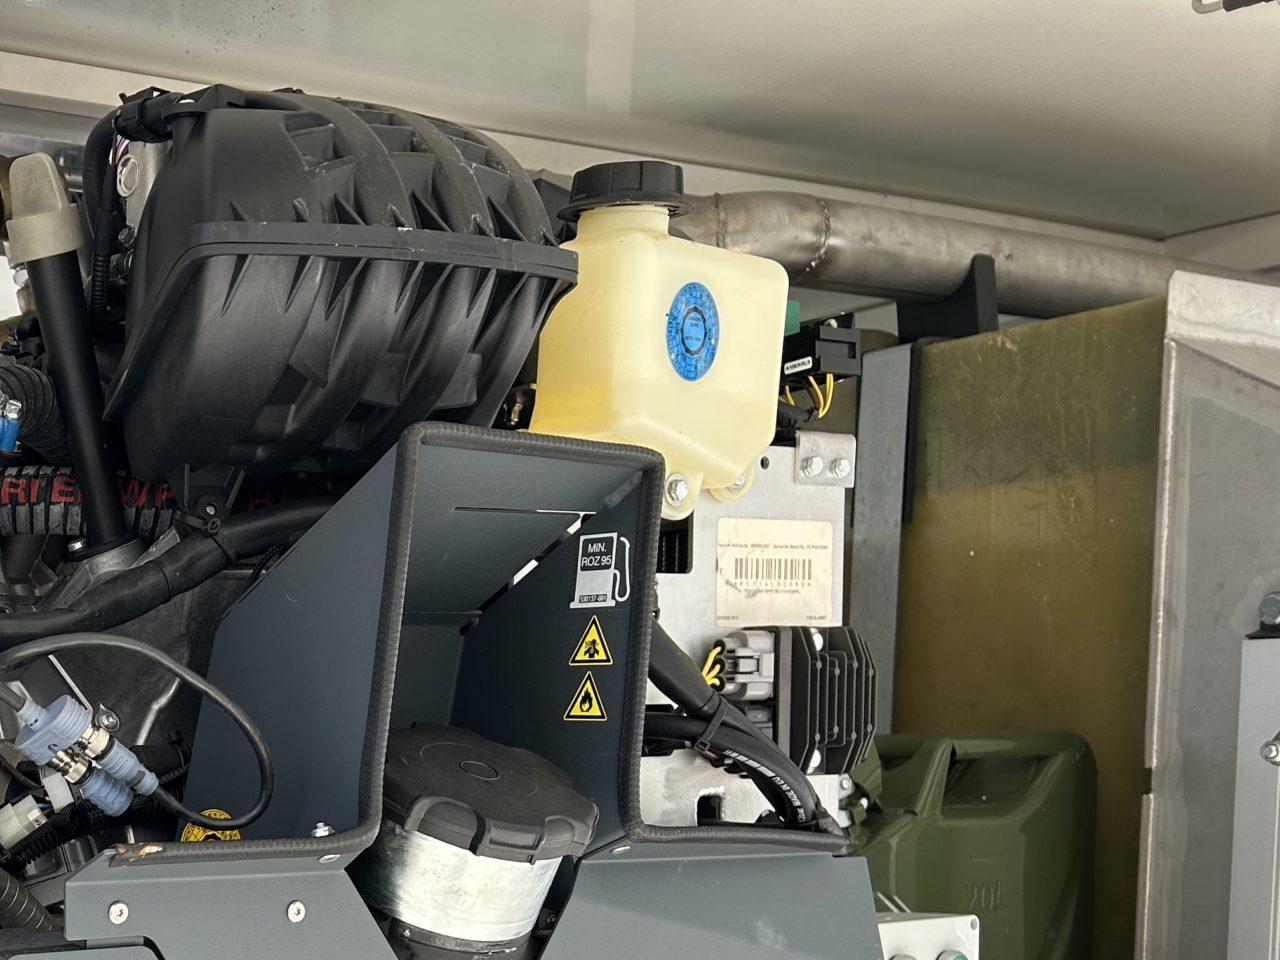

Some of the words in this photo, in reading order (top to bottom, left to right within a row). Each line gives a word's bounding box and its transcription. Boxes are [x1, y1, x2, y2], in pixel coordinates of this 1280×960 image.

[588, 542, 607, 553] MIN.
[581, 556, 600, 567] ROZ
[601, 555, 612, 565] 95
